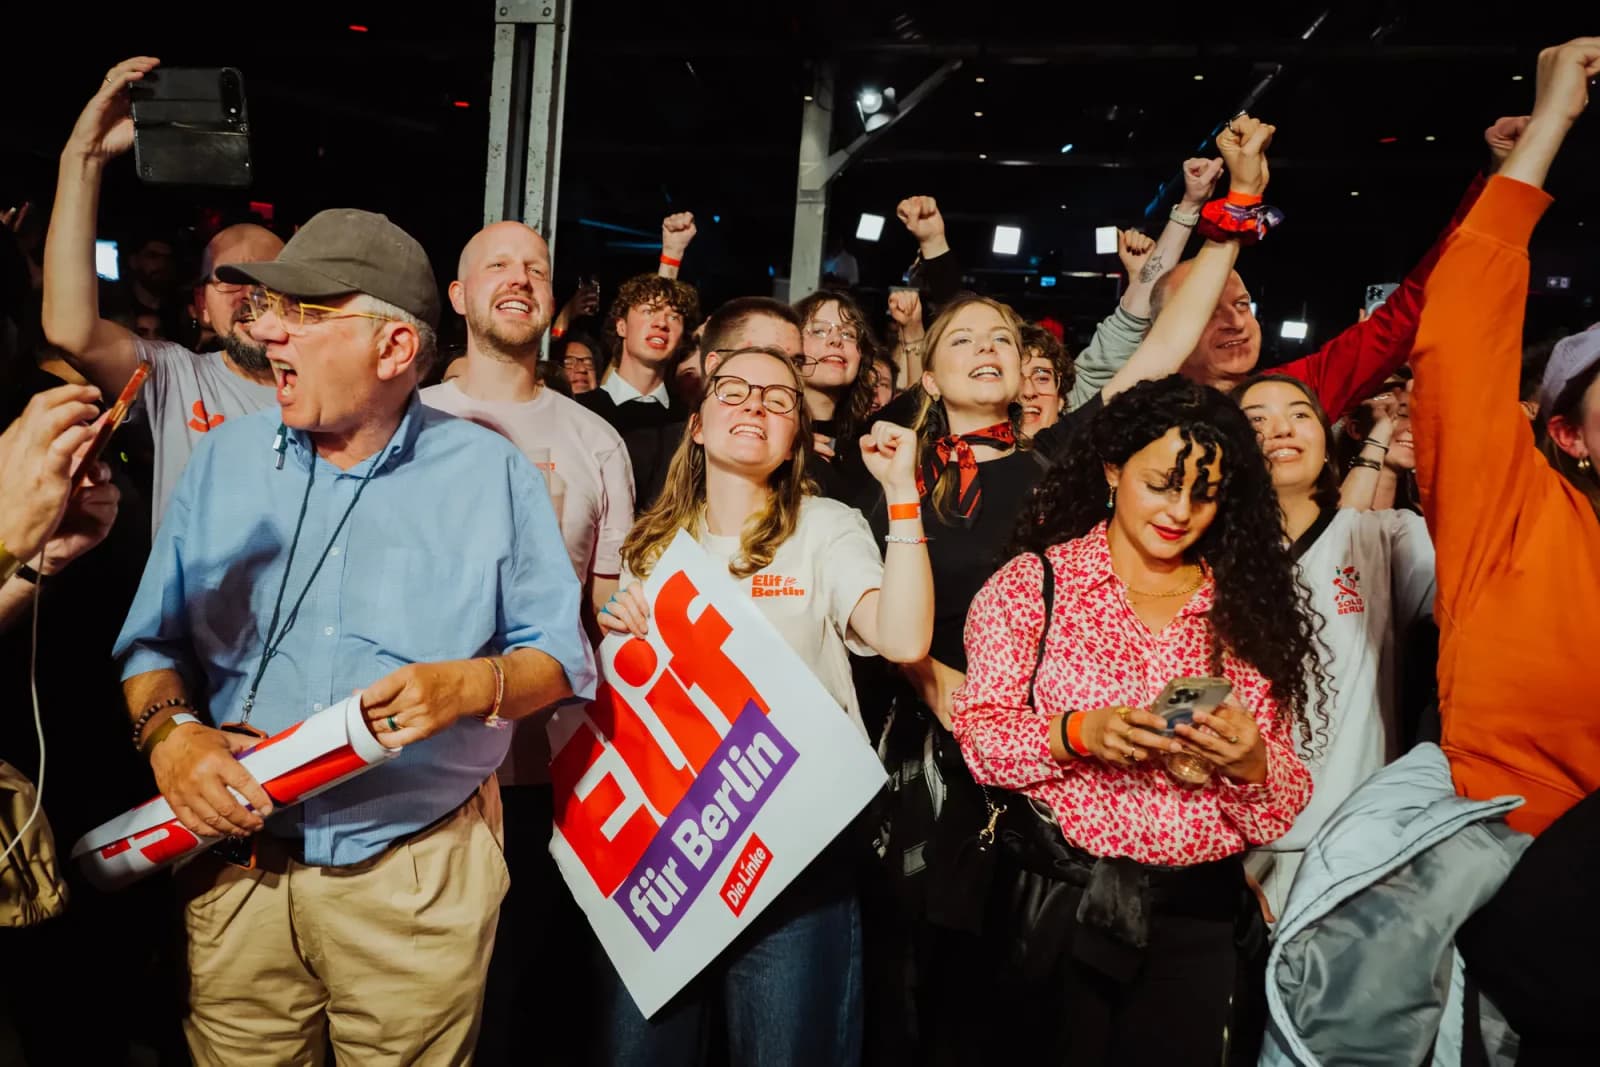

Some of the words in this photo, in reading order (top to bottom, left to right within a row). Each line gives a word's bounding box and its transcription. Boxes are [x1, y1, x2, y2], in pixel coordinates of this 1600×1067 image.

[751, 586, 805, 598] Berlin
[753, 574, 782, 586] Elif
[551, 569, 771, 900] Elif
[629, 856, 689, 934] für
[671, 732, 784, 871] Berlin
[726, 882, 746, 908] Die
